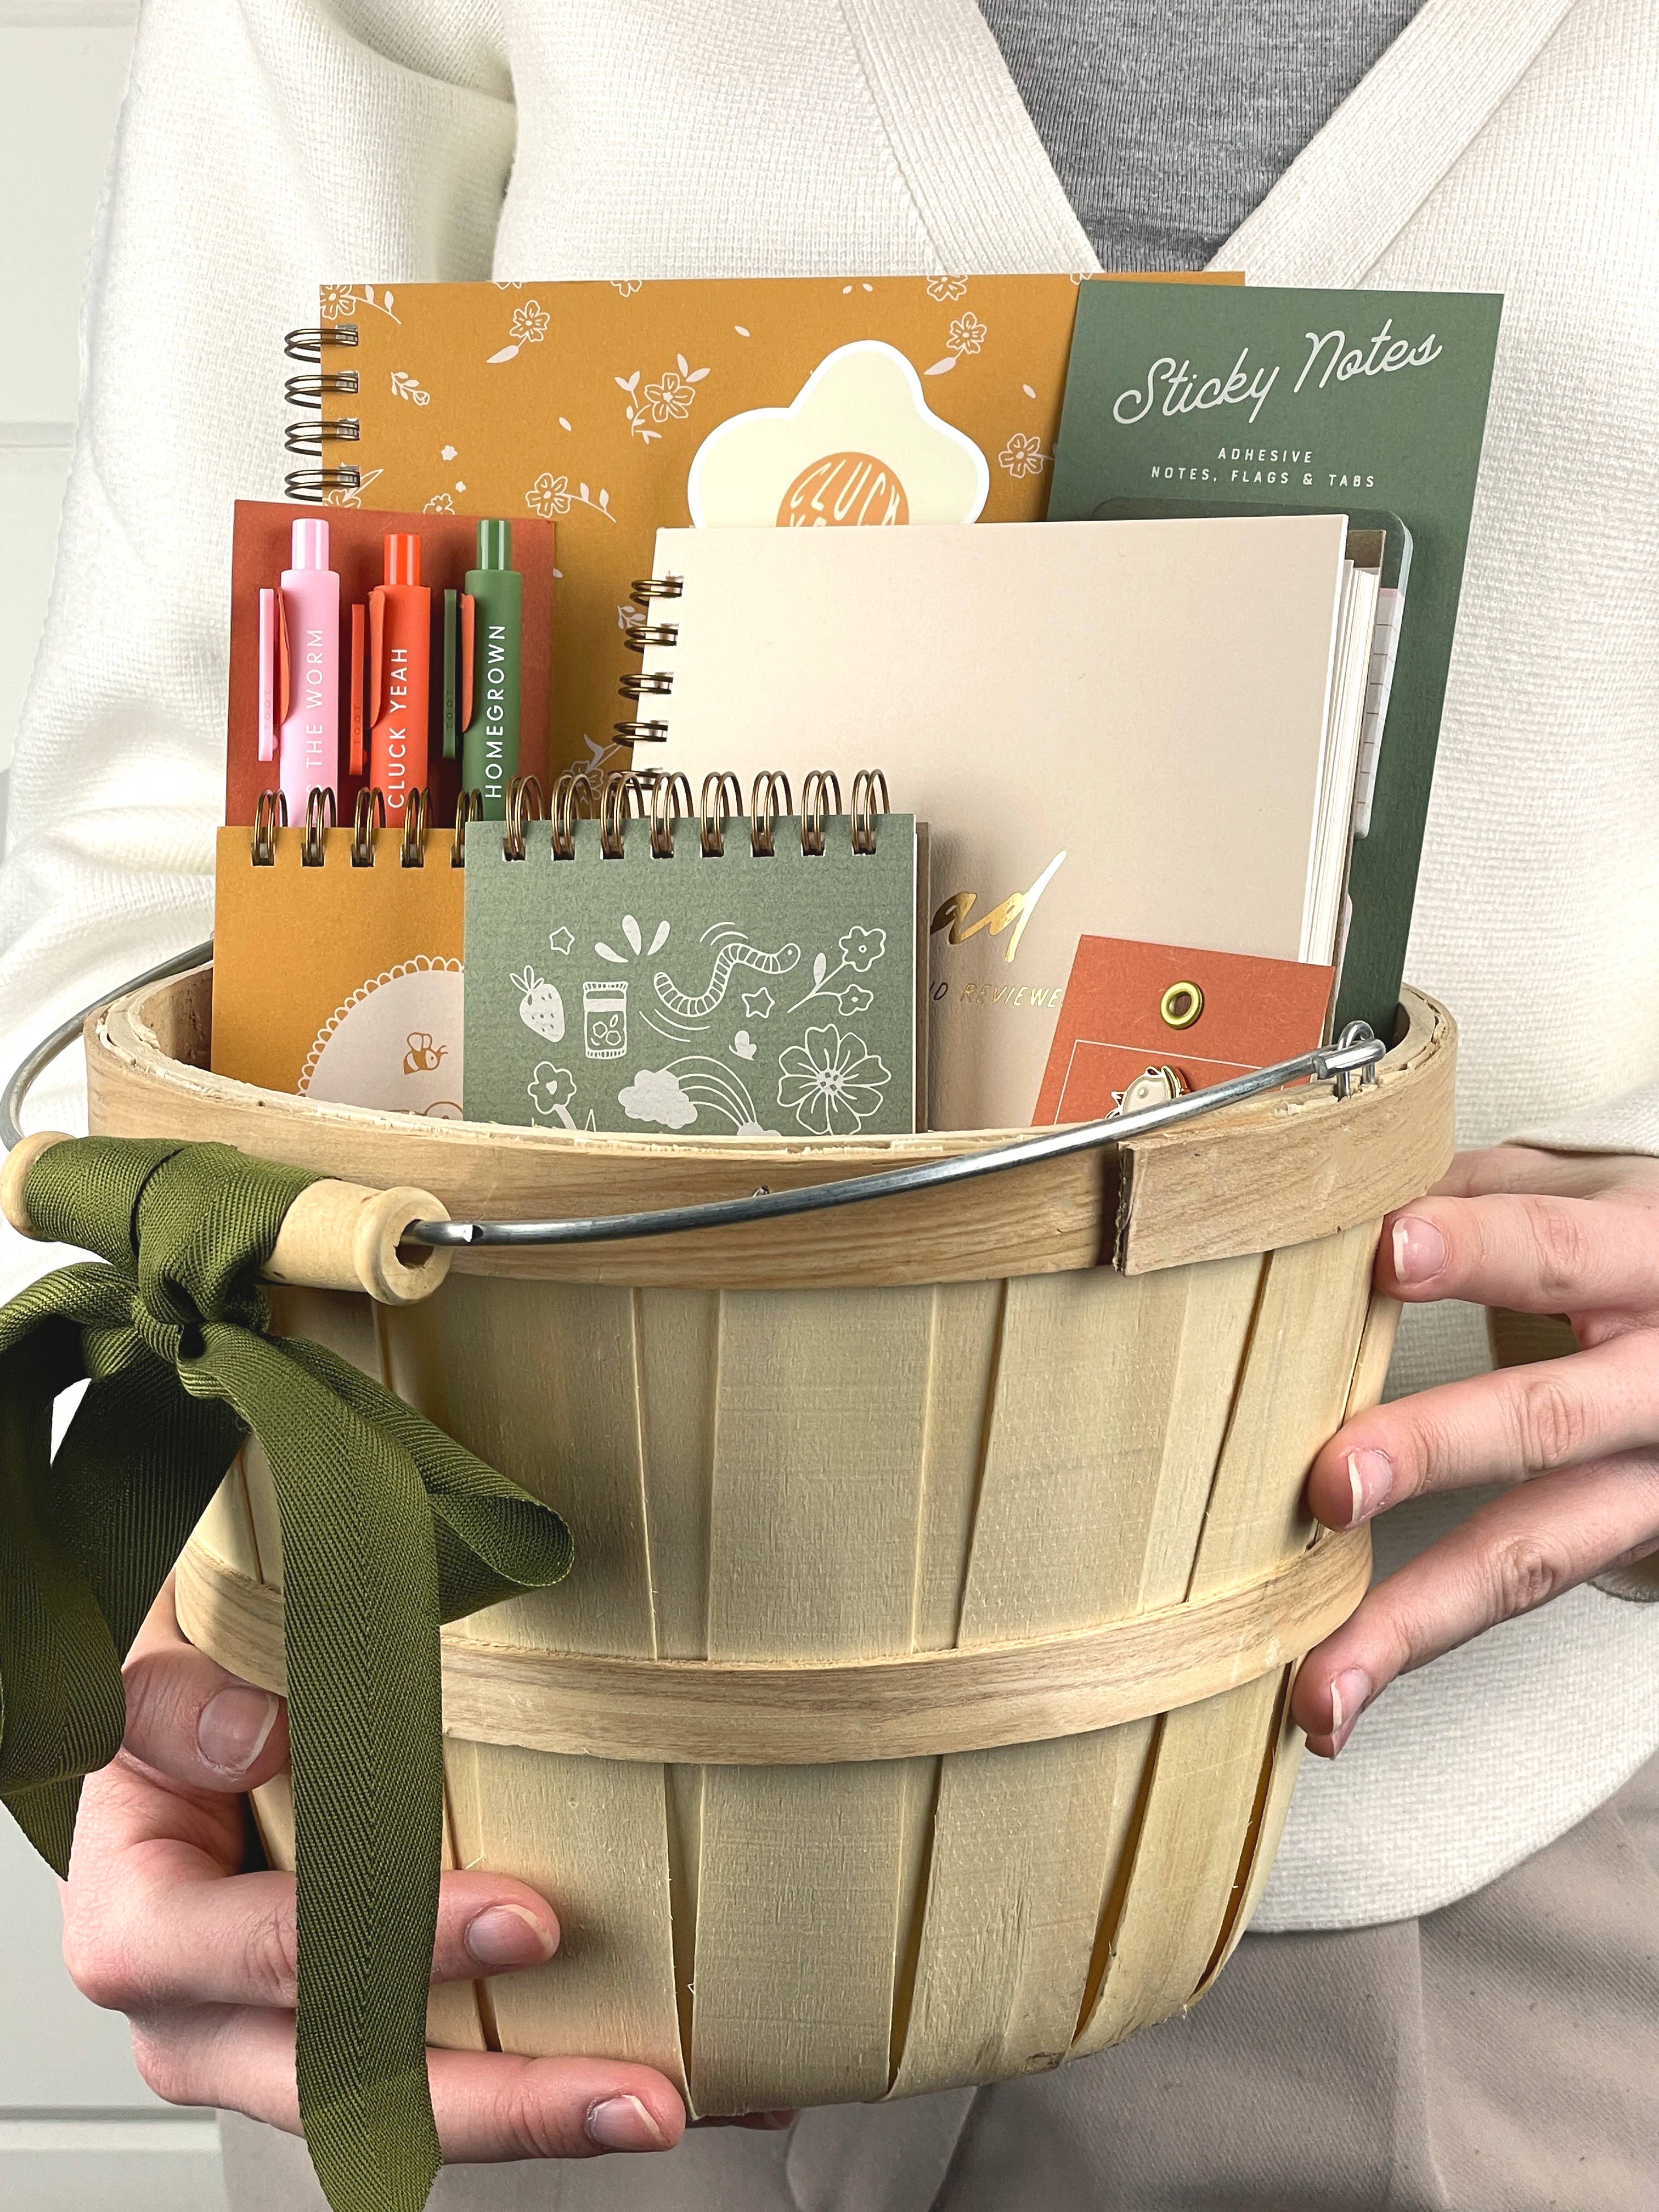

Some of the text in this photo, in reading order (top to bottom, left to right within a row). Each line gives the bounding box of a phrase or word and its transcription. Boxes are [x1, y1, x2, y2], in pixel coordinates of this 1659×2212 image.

[1113, 318, 1443, 425] Sticky Notes
[1150, 466, 1376, 489] NOTES, FLAGS & TABS
[1217, 447, 1314, 464] ADHESIVE
[306, 629, 324, 709] WORM
[387, 649, 408, 808] CLUCK YEAH
[484, 625, 505, 798] HOMEGROWN
[306, 725, 323, 769] THE
[960, 983, 1063, 1008] REVIEWE
